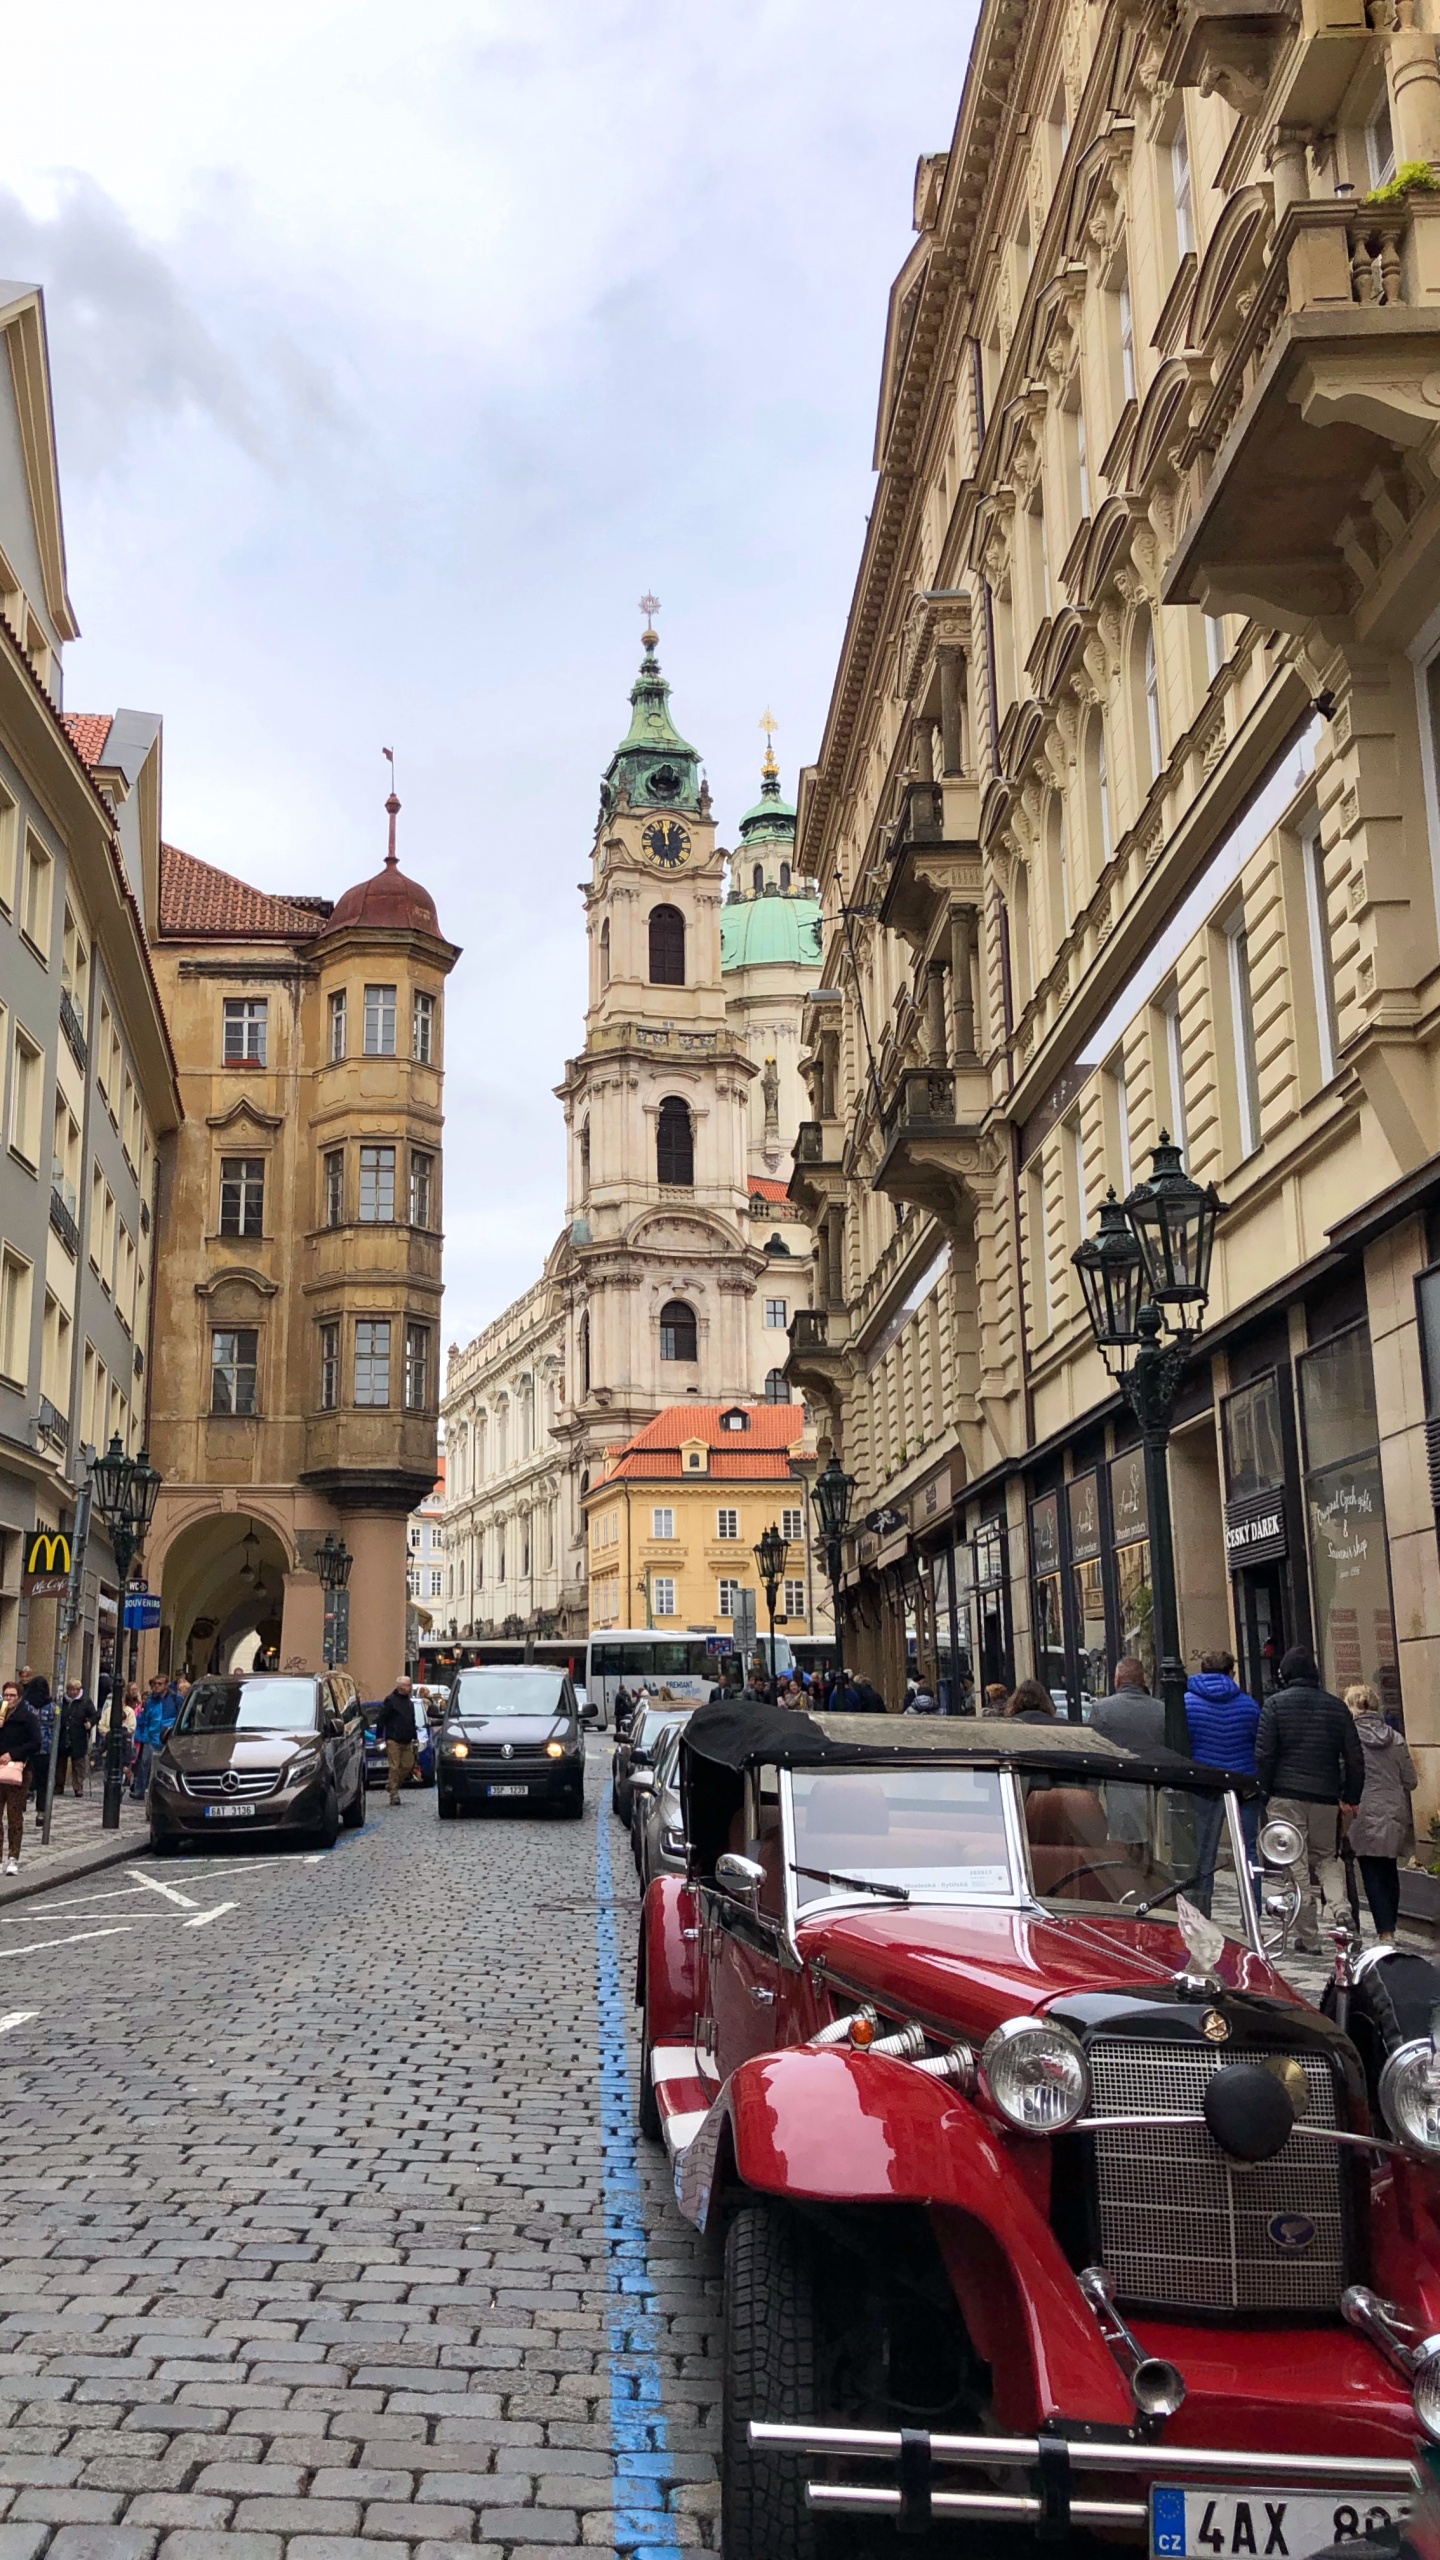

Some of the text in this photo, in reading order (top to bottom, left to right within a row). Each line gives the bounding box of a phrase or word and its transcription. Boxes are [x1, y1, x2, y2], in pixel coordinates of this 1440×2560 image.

[1341, 1485, 1357, 1514] Czech
[1226, 1515, 1280, 1548] ČESKÝ DÁREK
[129, 1582, 139, 1590] WC
[125, 1599, 160, 1608] SOUVENIRS
[211, 1806, 252, 1816] 6AT 3136
[1197, 2500, 1290, 2555] 4AX
[1158, 2534, 1182, 2550] CZ
